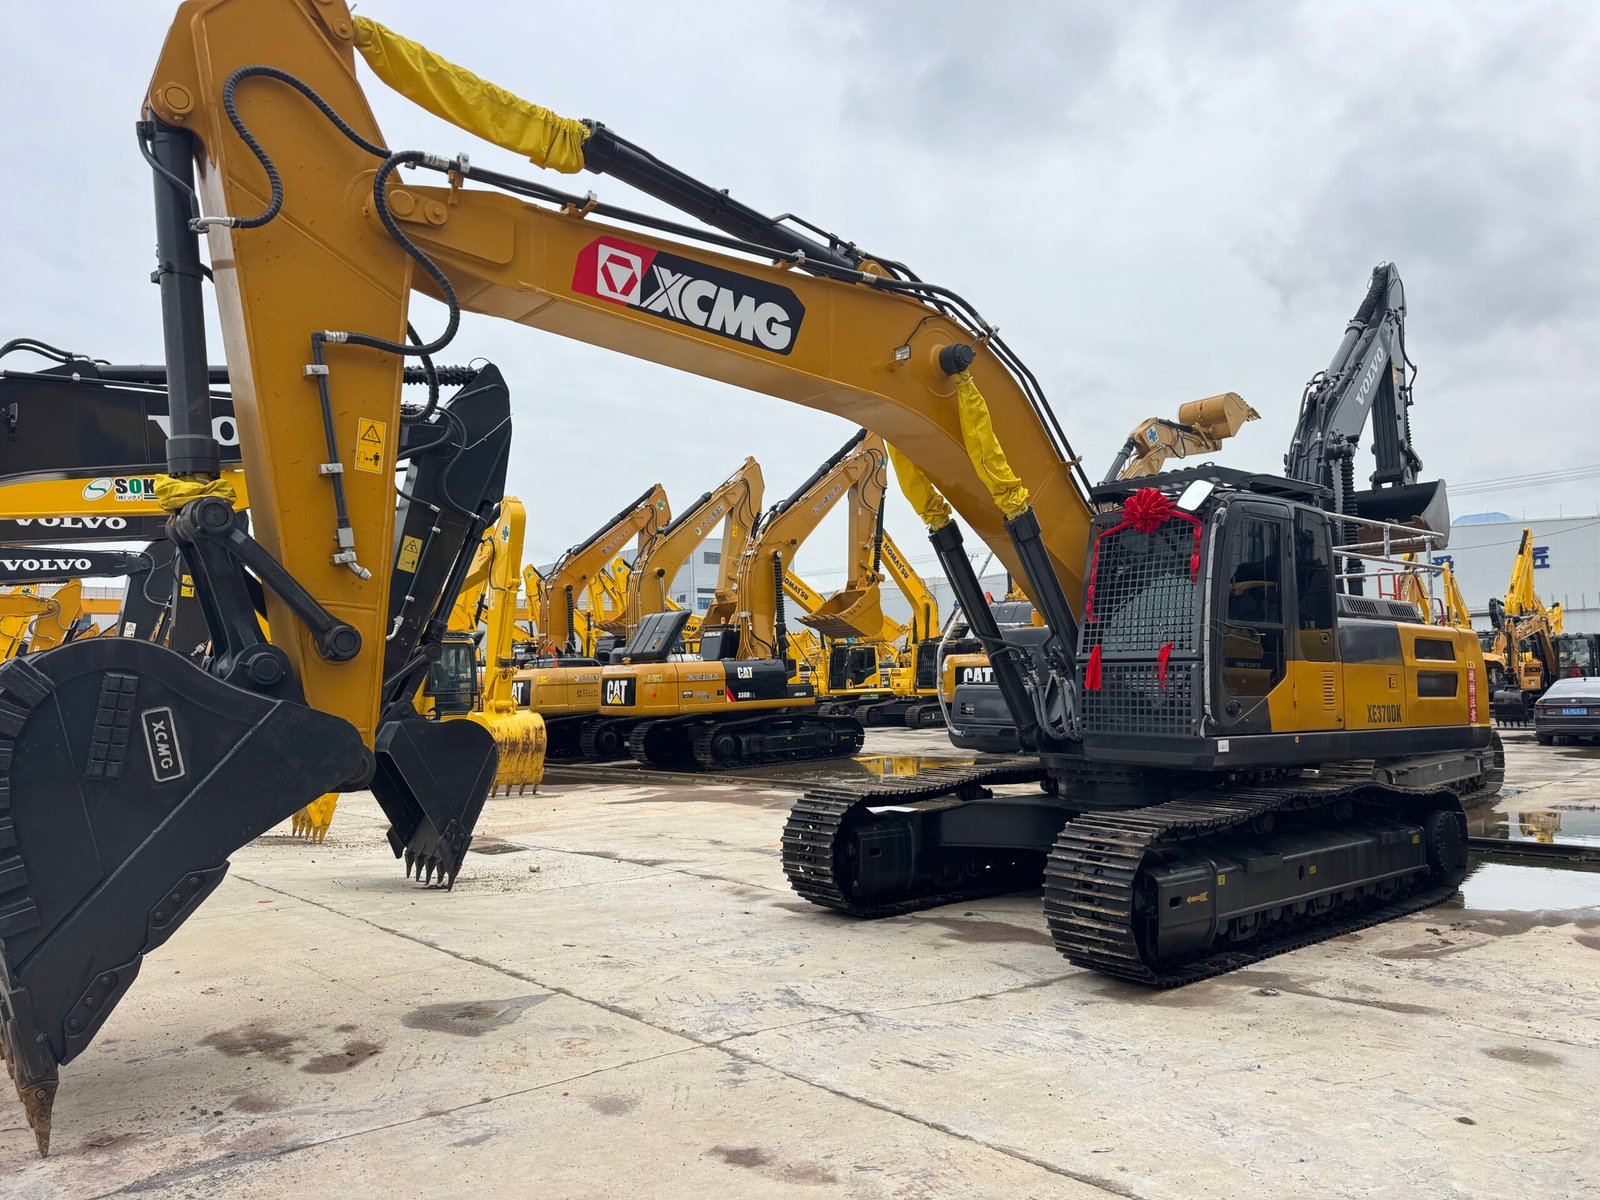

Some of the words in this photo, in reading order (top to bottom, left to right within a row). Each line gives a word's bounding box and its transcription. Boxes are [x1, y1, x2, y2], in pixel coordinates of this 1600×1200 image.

[641, 264, 792, 351] XCMG
[1355, 347, 1384, 405] VOLVO
[114, 478, 156, 494] SOK
[0, 558, 92, 571] VOLVO
[883, 543, 909, 579] KOMATSU
[784, 576, 809, 601] OMATSU
[736, 667, 753, 678] CAT
[963, 667, 993, 683] CAT
[511, 682, 524, 705] AT
[606, 680, 628, 704] CAT
[1367, 704, 1402, 723] XE370DK
[151, 720, 173, 769] XCMG
